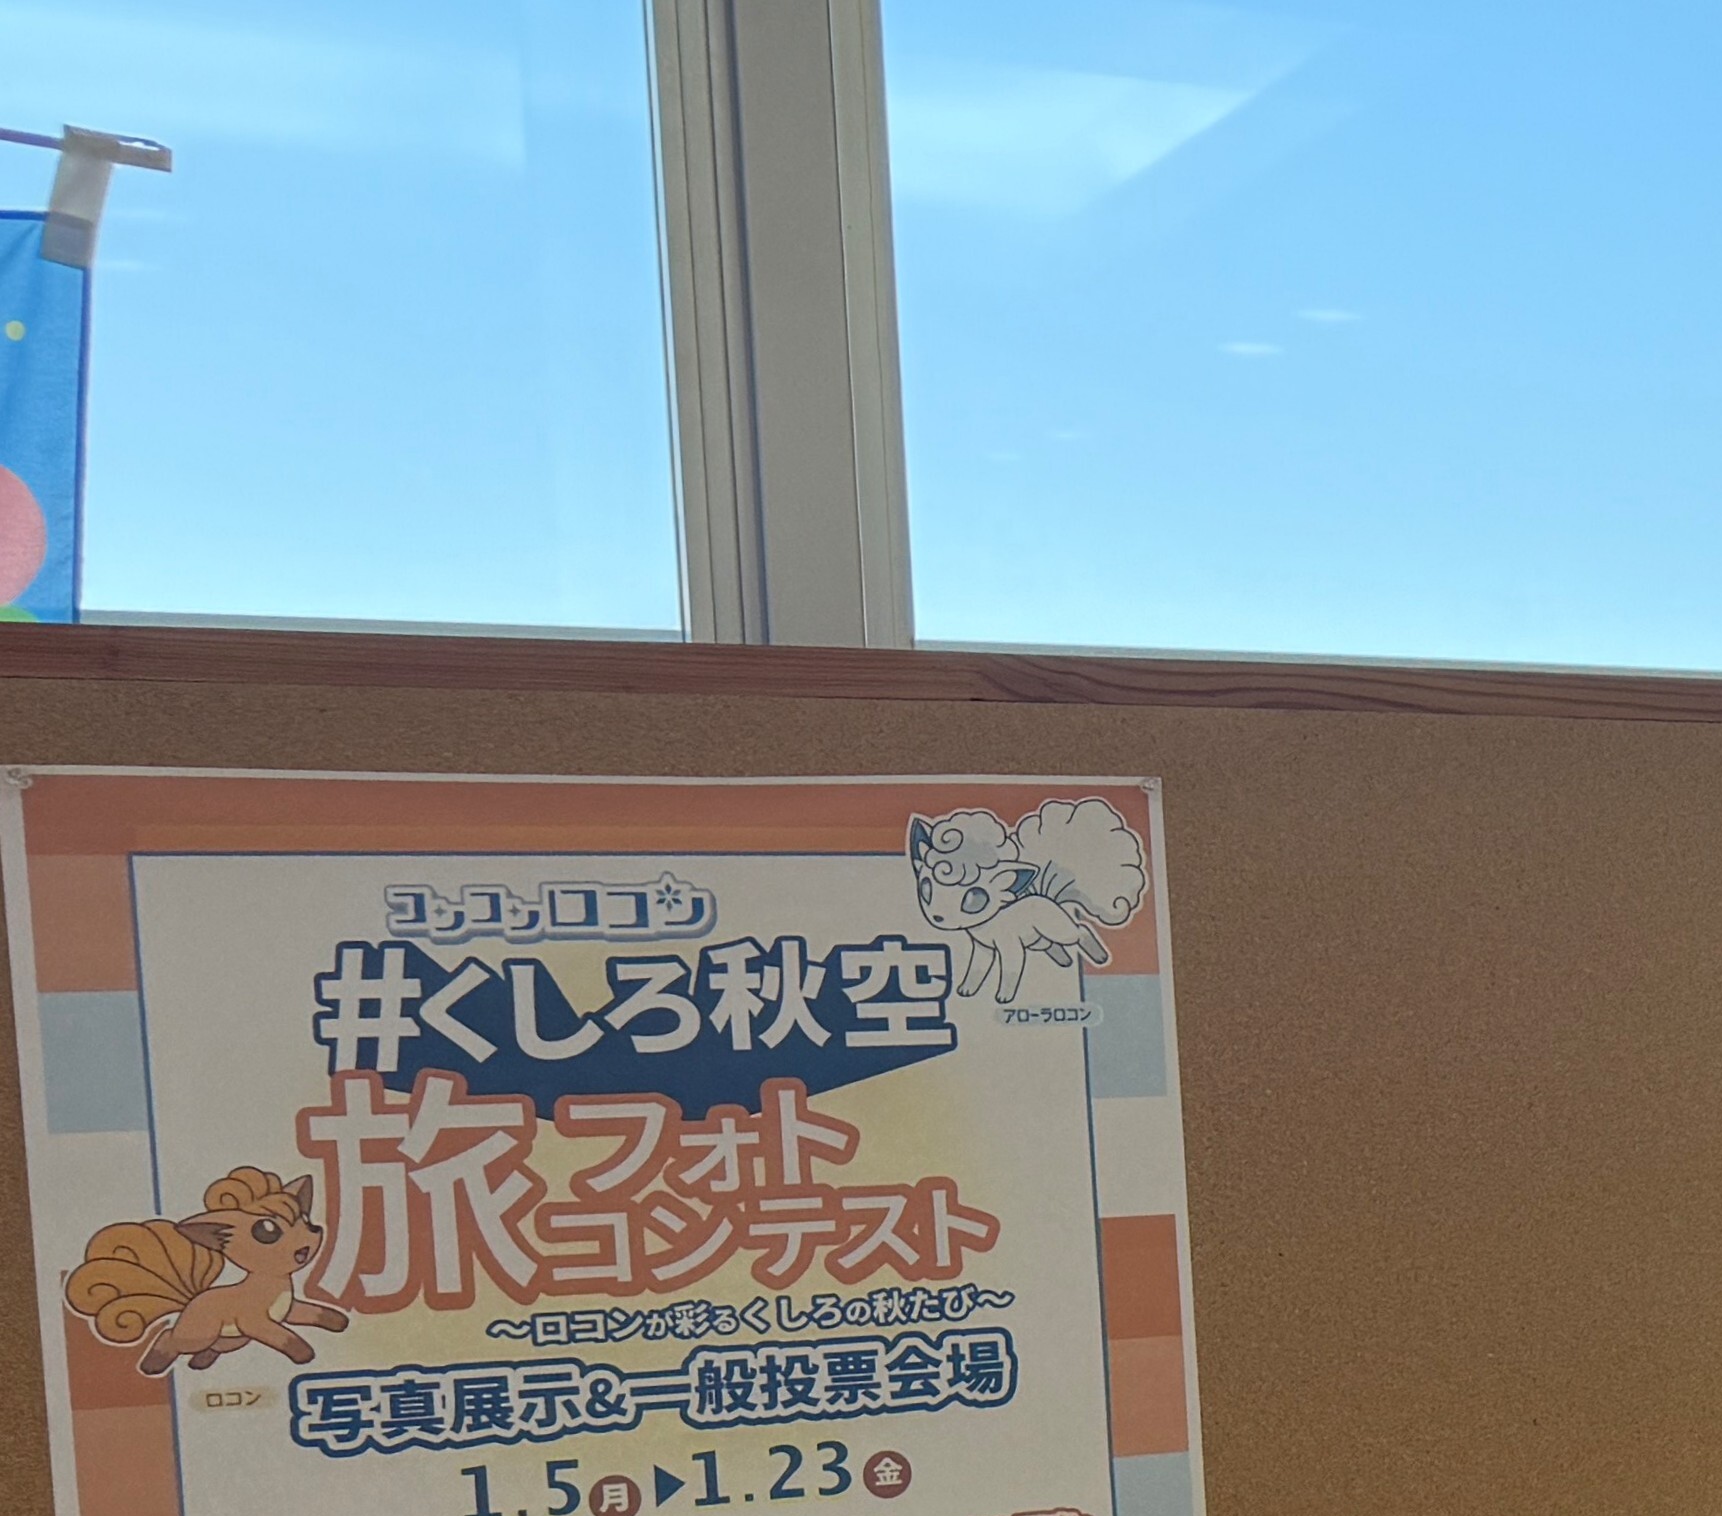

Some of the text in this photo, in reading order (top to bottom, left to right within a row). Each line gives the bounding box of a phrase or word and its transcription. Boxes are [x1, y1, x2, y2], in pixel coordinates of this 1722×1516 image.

[388, 878, 714, 940] コンコンロコン
[317, 940, 955, 1073] #くしろ秋空
[1003, 1006, 1092, 1024] アローラロコン
[306, 1074, 536, 1299] 旅
[566, 1087, 852, 1194] フォト
[546, 1187, 992, 1284] コンテスト
[206, 1391, 263, 1408] ロコン
[300, 1336, 1008, 1446] 写真展示&一般投票会場
[691, 1440, 853, 1507] 1.23
[867, 1454, 908, 1493] 金
